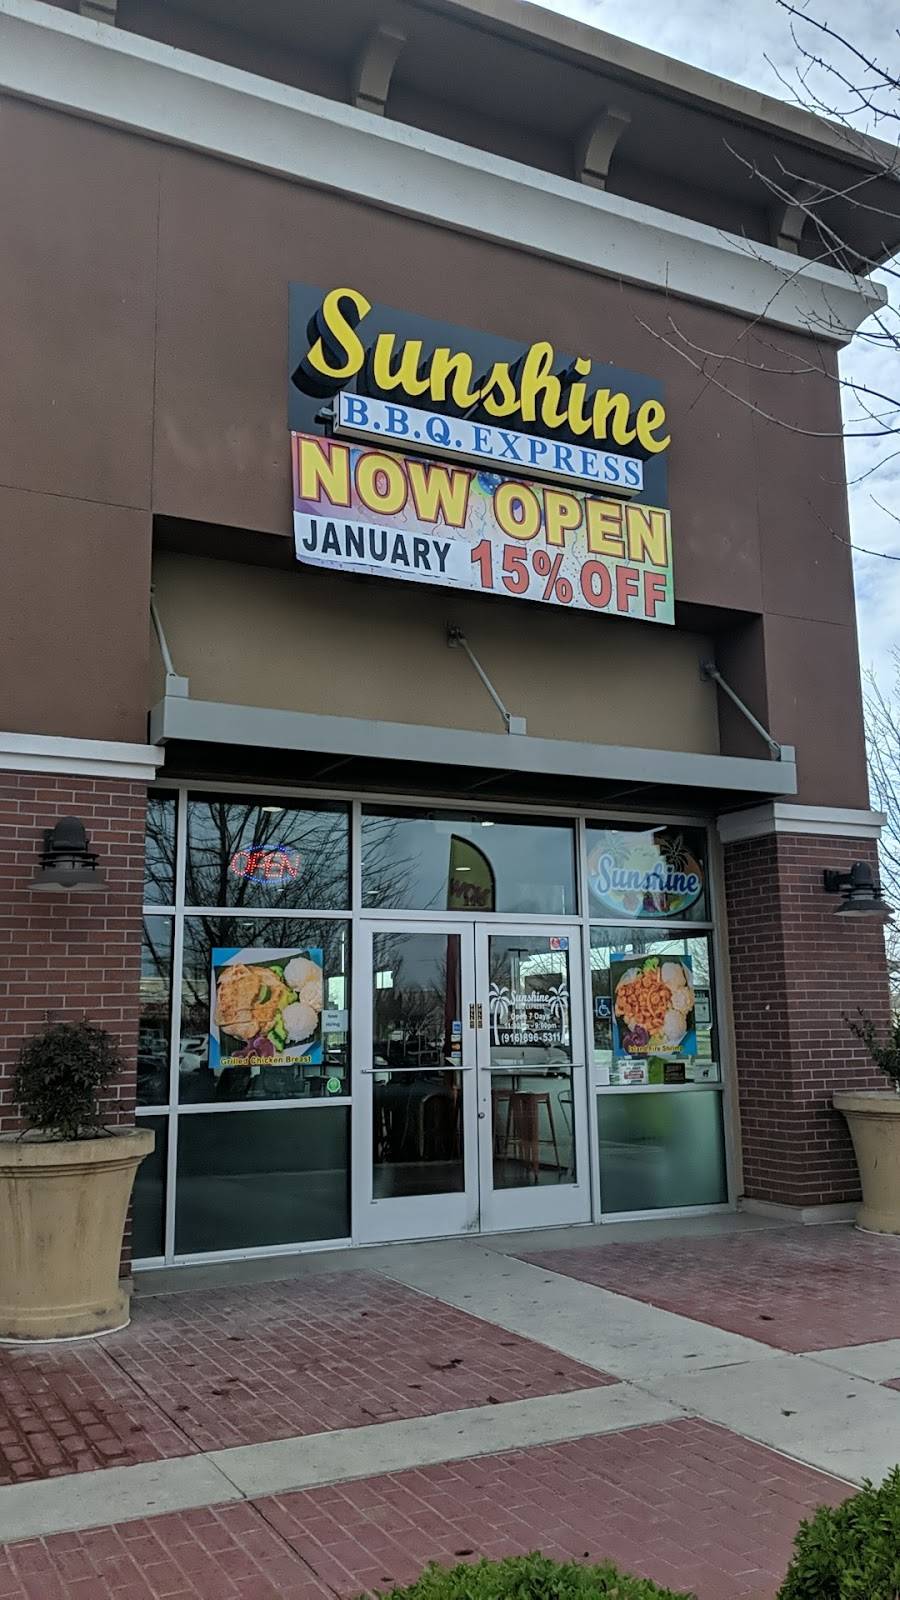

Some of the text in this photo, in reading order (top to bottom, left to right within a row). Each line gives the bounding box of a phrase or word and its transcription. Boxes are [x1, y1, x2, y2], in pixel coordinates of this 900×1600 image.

[307, 287, 671, 453] Sunshine
[471, 424, 642, 487] EXPRESS
[299, 436, 669, 568] NOW OPEN
[302, 518, 452, 573] JANUARY
[231, 851, 300, 880] OPEN
[596, 854, 700, 895] Sunshine
[510, 990, 549, 1004] Sunshine
[221, 1054, 312, 1066] Grilled Chicken Breast
